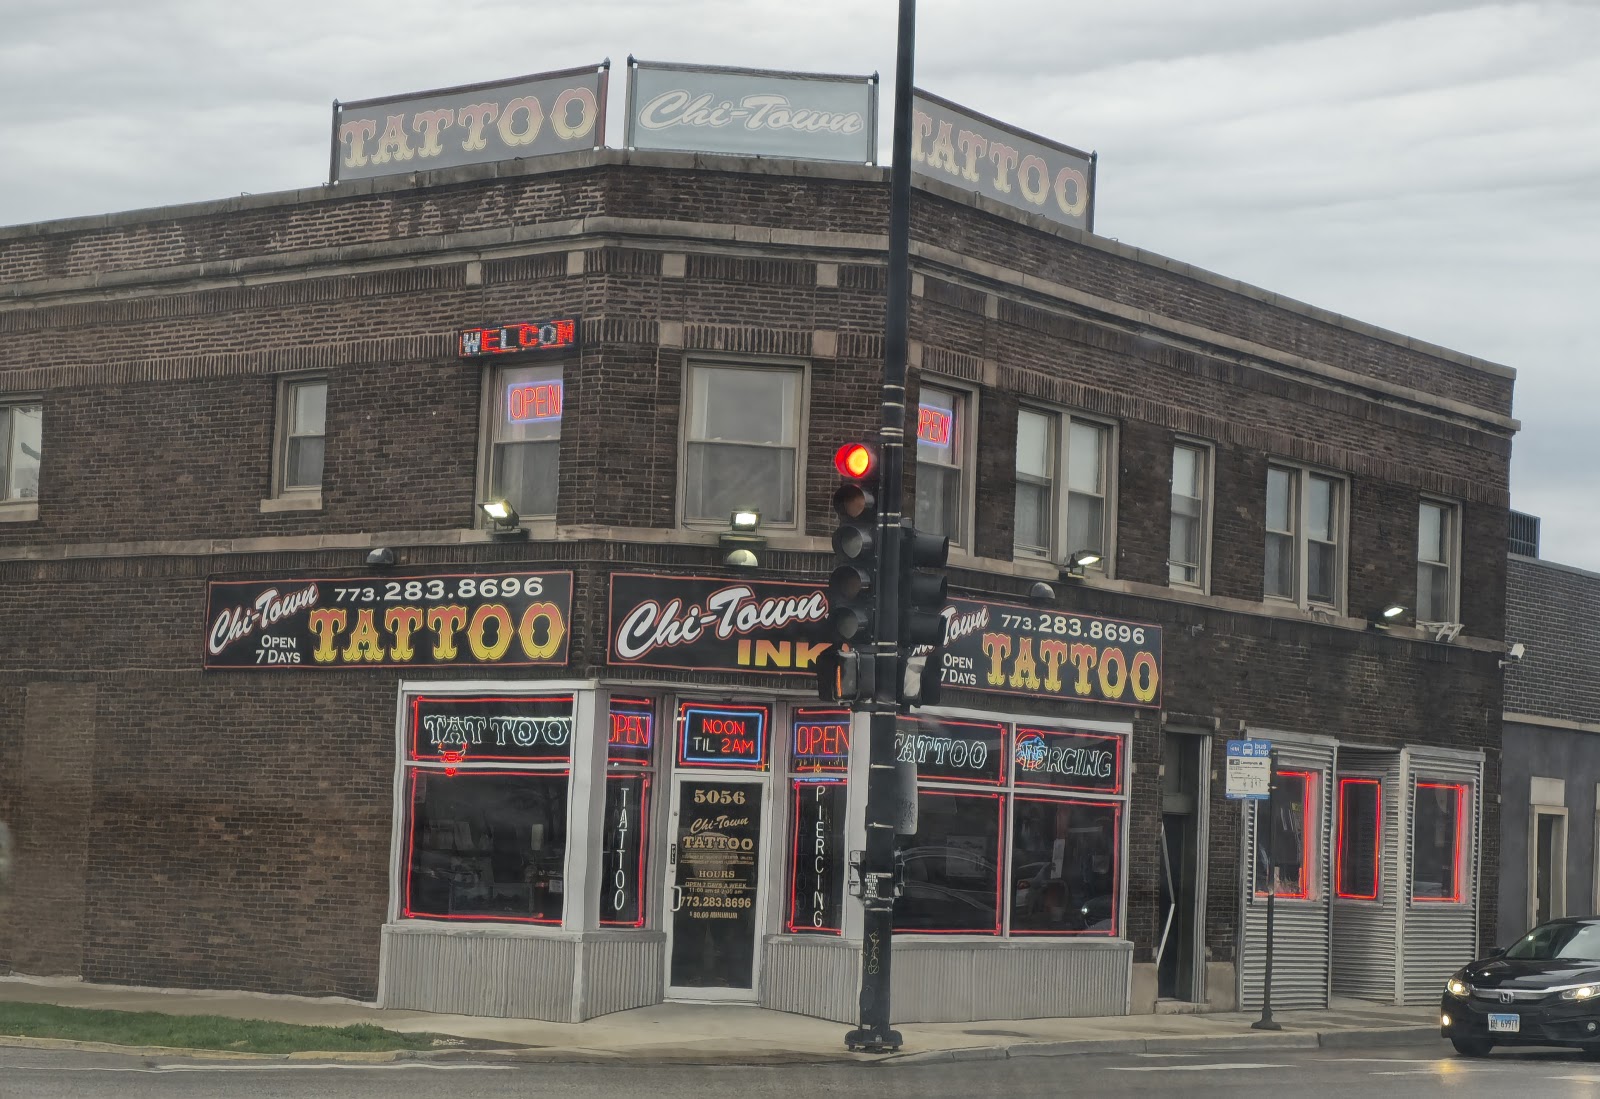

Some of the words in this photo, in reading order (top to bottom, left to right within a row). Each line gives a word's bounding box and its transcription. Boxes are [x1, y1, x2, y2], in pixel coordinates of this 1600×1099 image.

[639, 90, 864, 134] Chi-Town
[339, 87, 598, 168] TATTOO
[511, 384, 560, 419] OPEN
[334, 576, 544, 602] 773.283.8696
[209, 582, 319, 655] Chi-Town
[616, 586, 829, 660] Chi-Town
[1001, 614, 1145, 645] 773.283.8696
[261, 634, 297, 649] OPEN
[309, 602, 566, 662] TATTOO
[255, 650, 266, 664] 7
[943, 653, 973, 670] OPEN
[982, 632, 1159, 701] TATTOO
[941, 668, 947, 682] 7
[424, 714, 571, 746] TATTOO
[703, 718, 745, 735] NOON
[693, 737, 715, 752] TIL
[721, 738, 754, 754] 2AM
[694, 789, 746, 805] 5056
[690, 815, 749, 834] Chi-Town
[614, 788, 629, 910] TATTOO
[683, 836, 754, 850] TATTOO
[814, 786, 825, 927] PIERCING
[699, 870, 735, 878] HOURS
[681, 896, 751, 908] 773.283.8696
